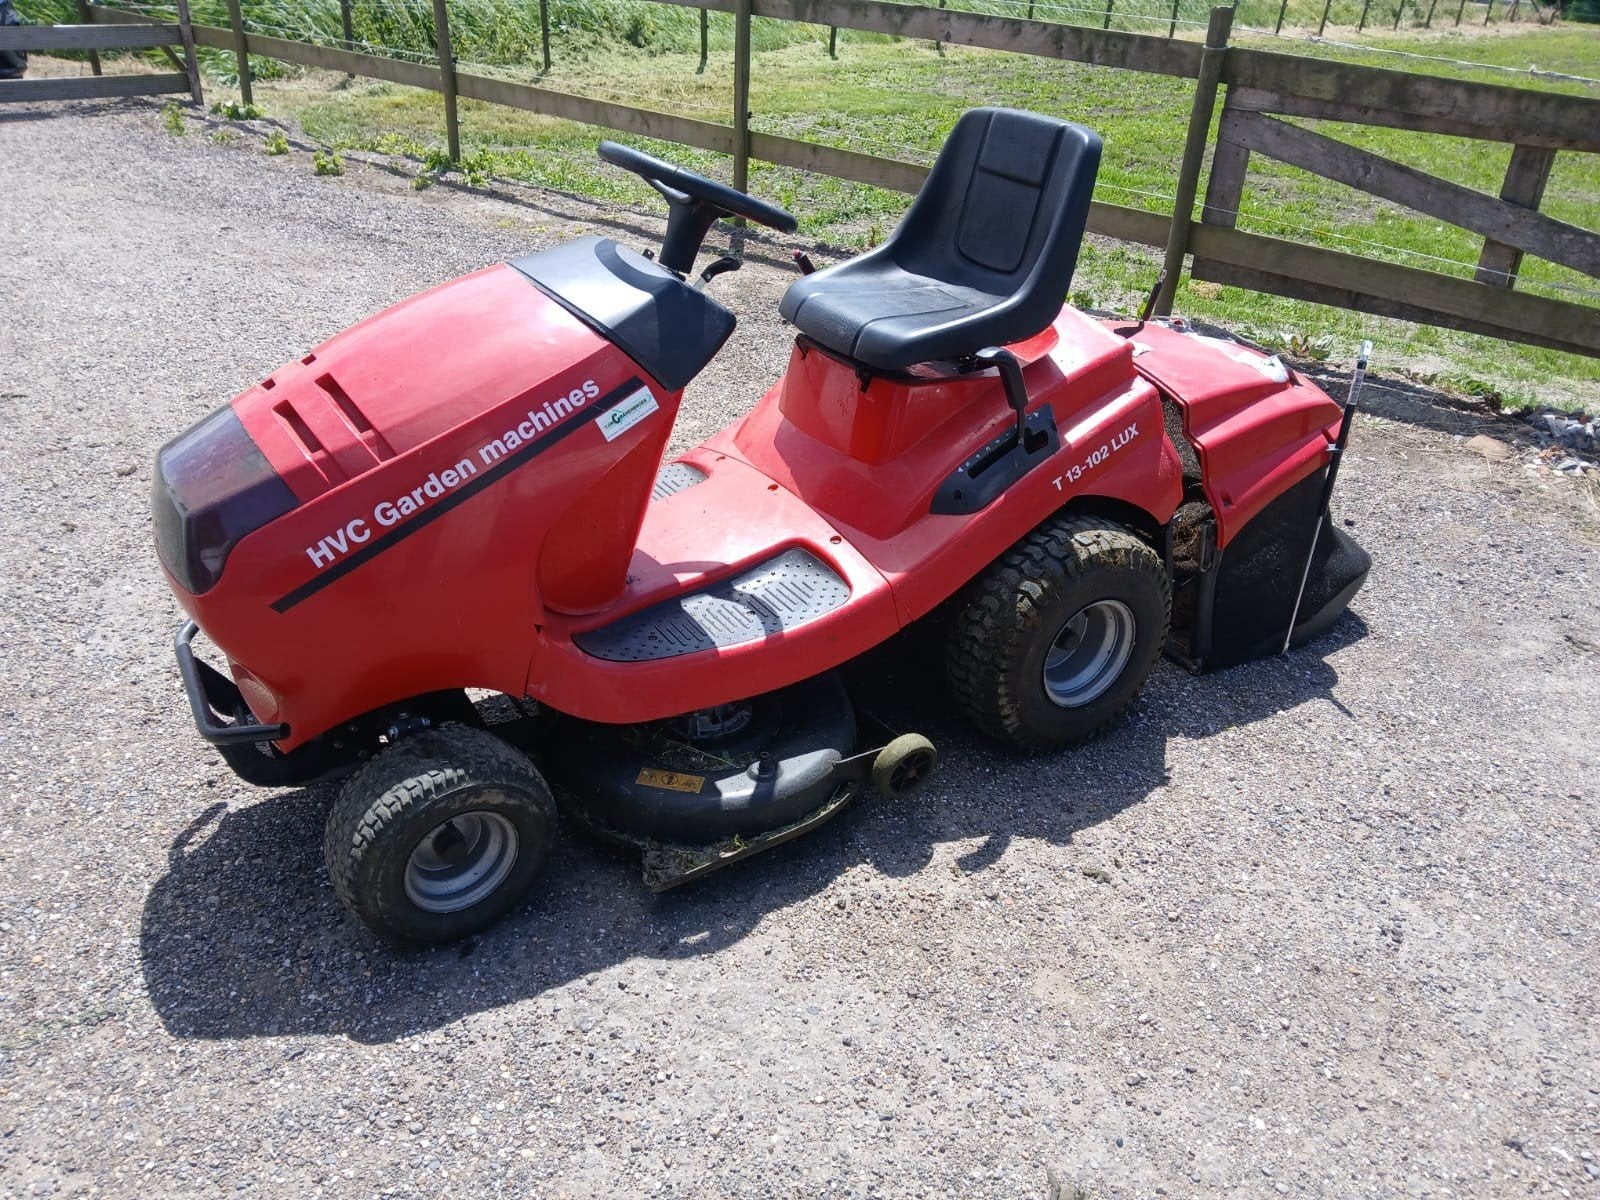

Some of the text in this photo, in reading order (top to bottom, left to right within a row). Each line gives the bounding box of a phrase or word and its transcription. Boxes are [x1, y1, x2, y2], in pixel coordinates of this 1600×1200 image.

[306, 519, 371, 569] HVC
[374, 458, 477, 527] Garden
[478, 378, 600, 465] machines
[1052, 423, 1140, 491] T 13-102 LUX
